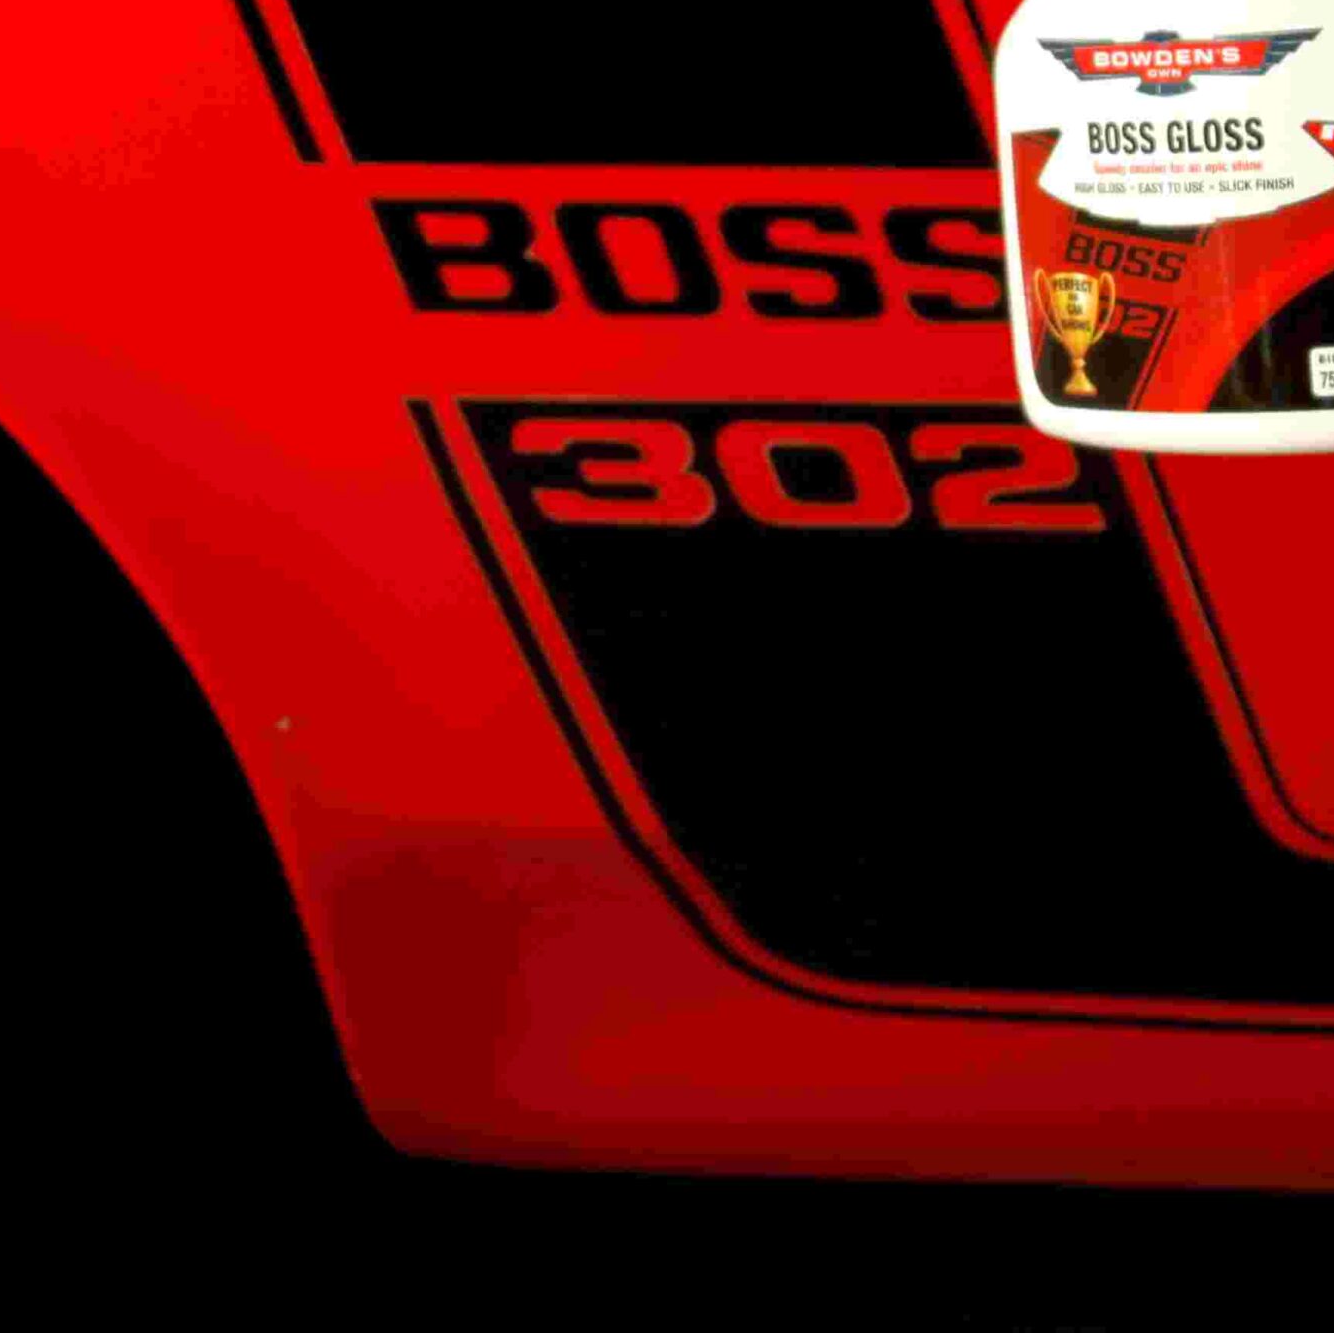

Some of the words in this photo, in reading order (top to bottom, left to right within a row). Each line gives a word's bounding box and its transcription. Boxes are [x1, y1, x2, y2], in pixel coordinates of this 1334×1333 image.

[1092, 46, 1241, 67] BOWDEN'S
[1087, 120, 1157, 155] BOSS
[1167, 117, 1265, 154] GLOSS
[1138, 181, 1164, 194] EASY
[1184, 180, 1205, 194] USE
[1255, 176, 1295, 191] FINISH
[370, 199, 1009, 323] BOSS
[1065, 232, 1187, 283] BOSS
[511, 418, 1106, 533] 302
